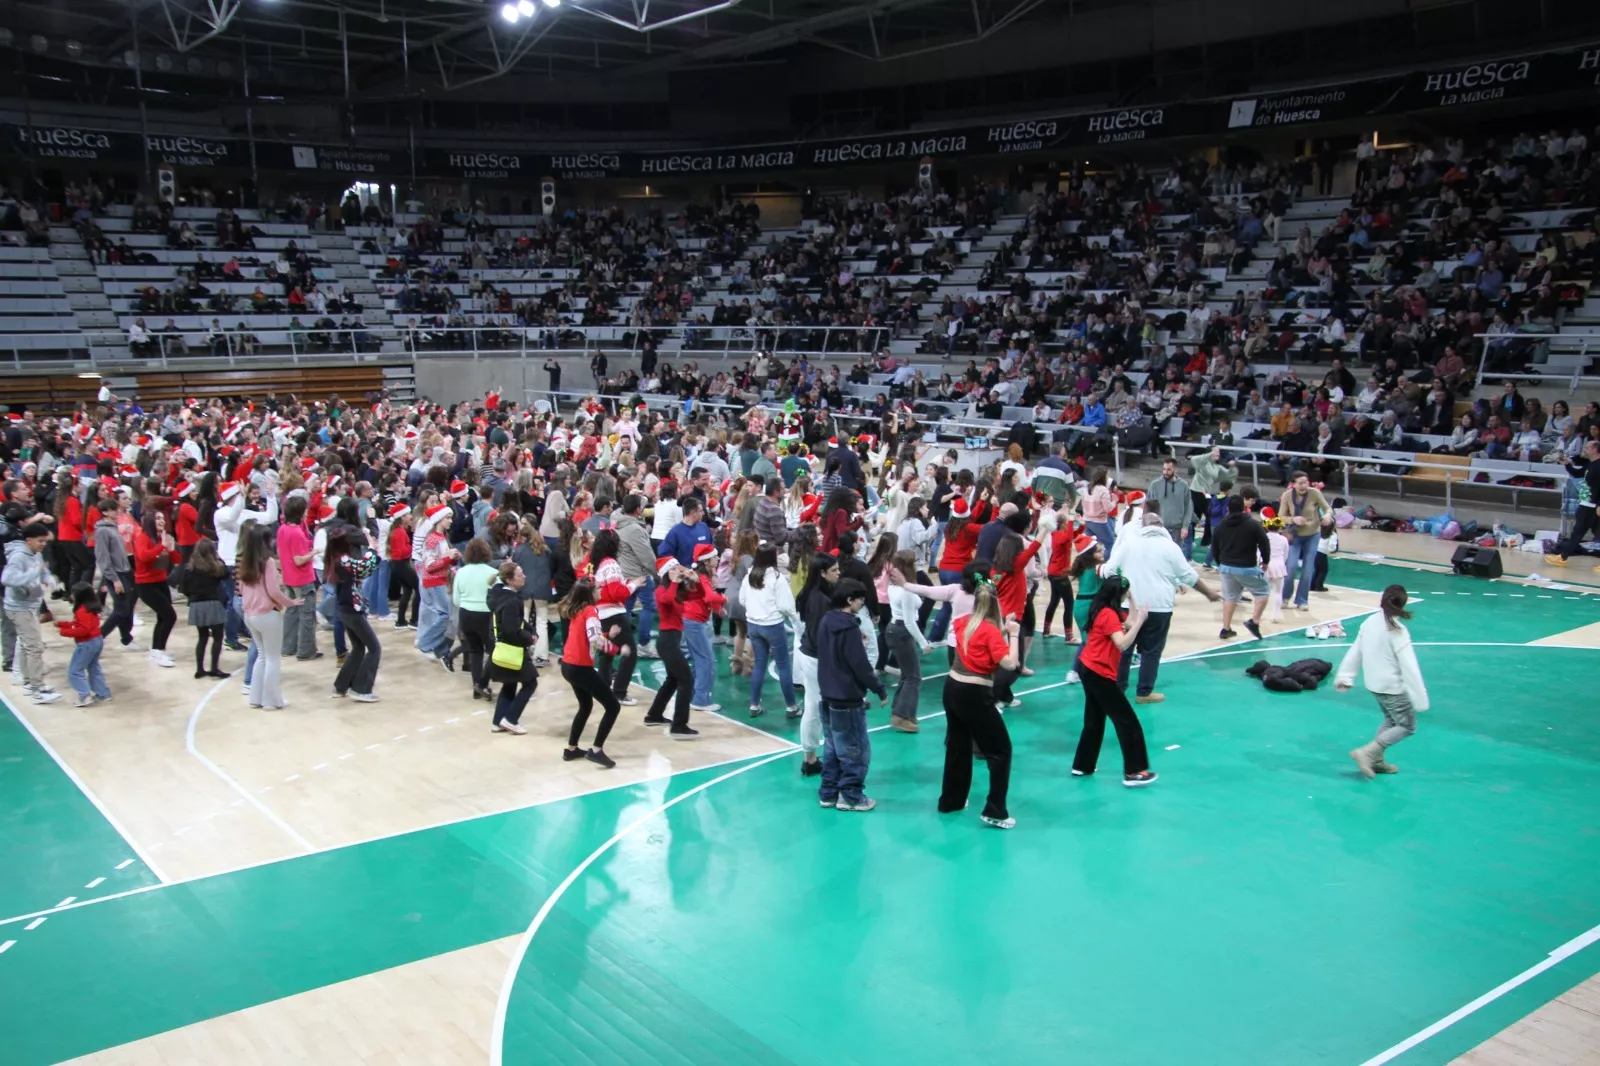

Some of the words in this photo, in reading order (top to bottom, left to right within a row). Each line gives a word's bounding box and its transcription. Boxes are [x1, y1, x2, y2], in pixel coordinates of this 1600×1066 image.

[1423, 61, 1531, 92] Huesca
[1258, 90, 1347, 111] Ayuntamiento
[1087, 109, 1164, 133] Huesca
[1255, 114, 1272, 126] de
[1274, 108, 1321, 124] Huesca
[987, 120, 1058, 142] Huesca
[146, 135, 229, 156] Huesca
[813, 142, 882, 163] Huesca
[449, 153, 521, 169] Huesca
[551, 153, 621, 169] Huesca
[640, 155, 712, 173] Huesca
